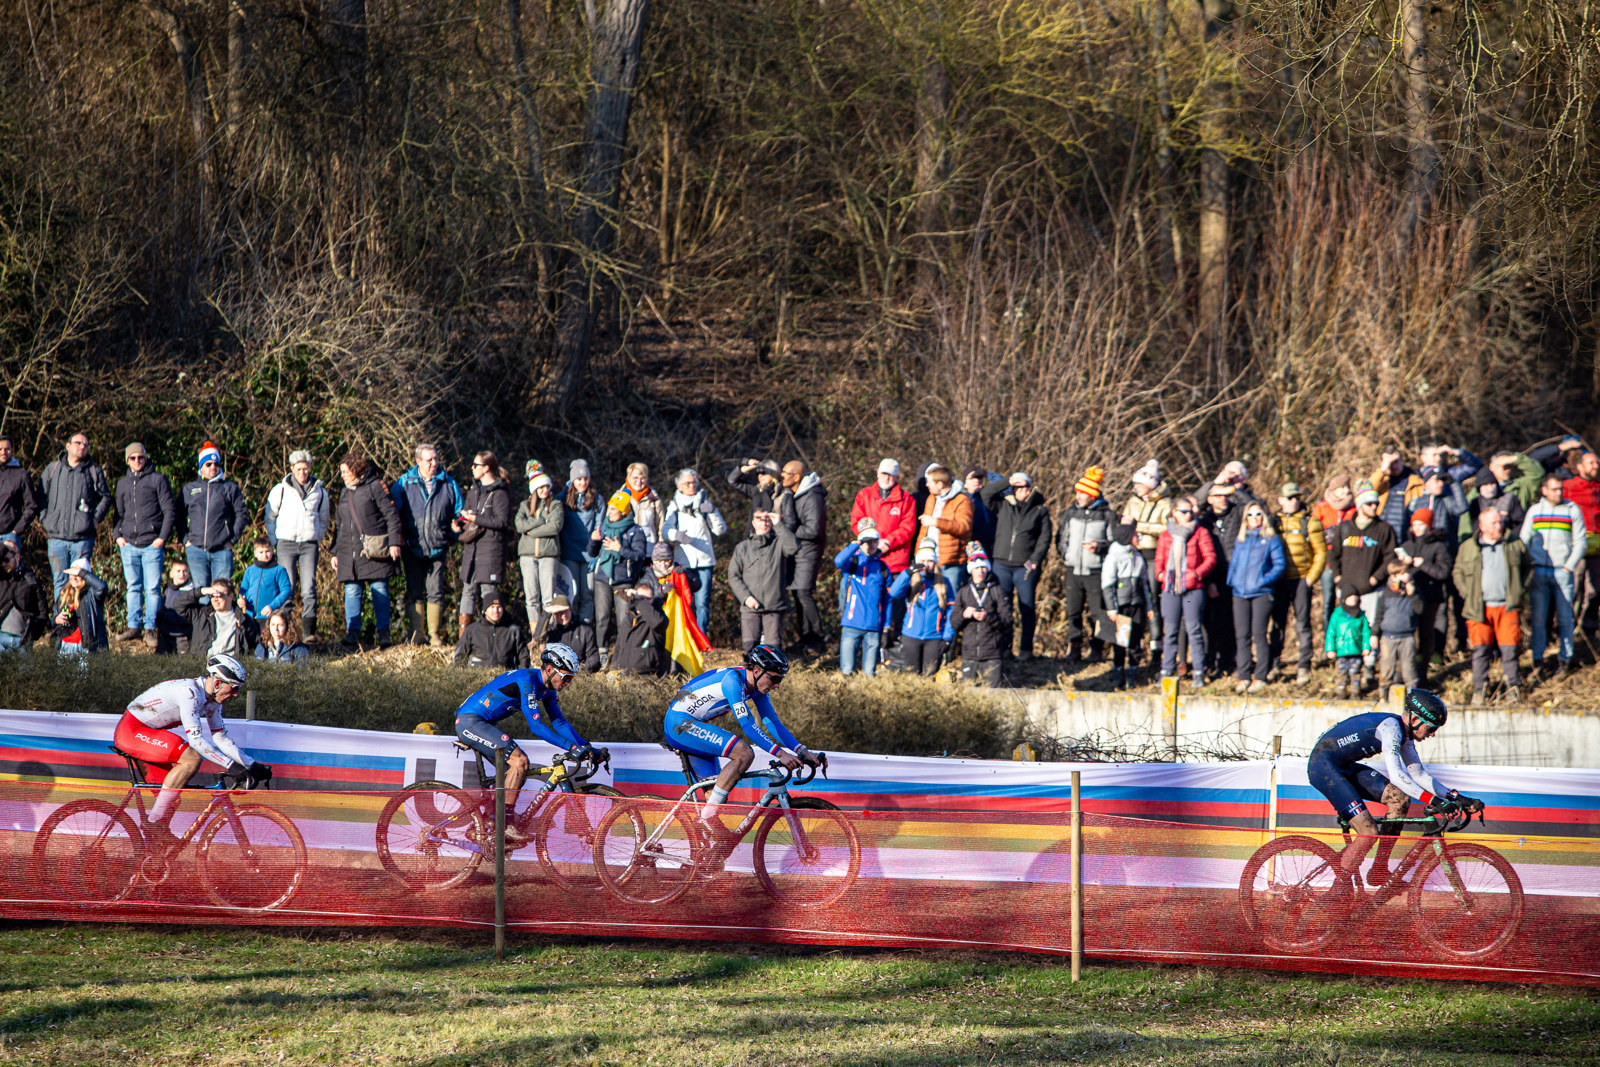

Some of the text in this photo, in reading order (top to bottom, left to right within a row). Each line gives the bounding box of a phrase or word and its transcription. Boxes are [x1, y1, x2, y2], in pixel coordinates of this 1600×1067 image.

[735, 706, 746, 715] 20
[135, 733, 168, 749] POLSKA
[1337, 733, 1360, 748] FRANCE
